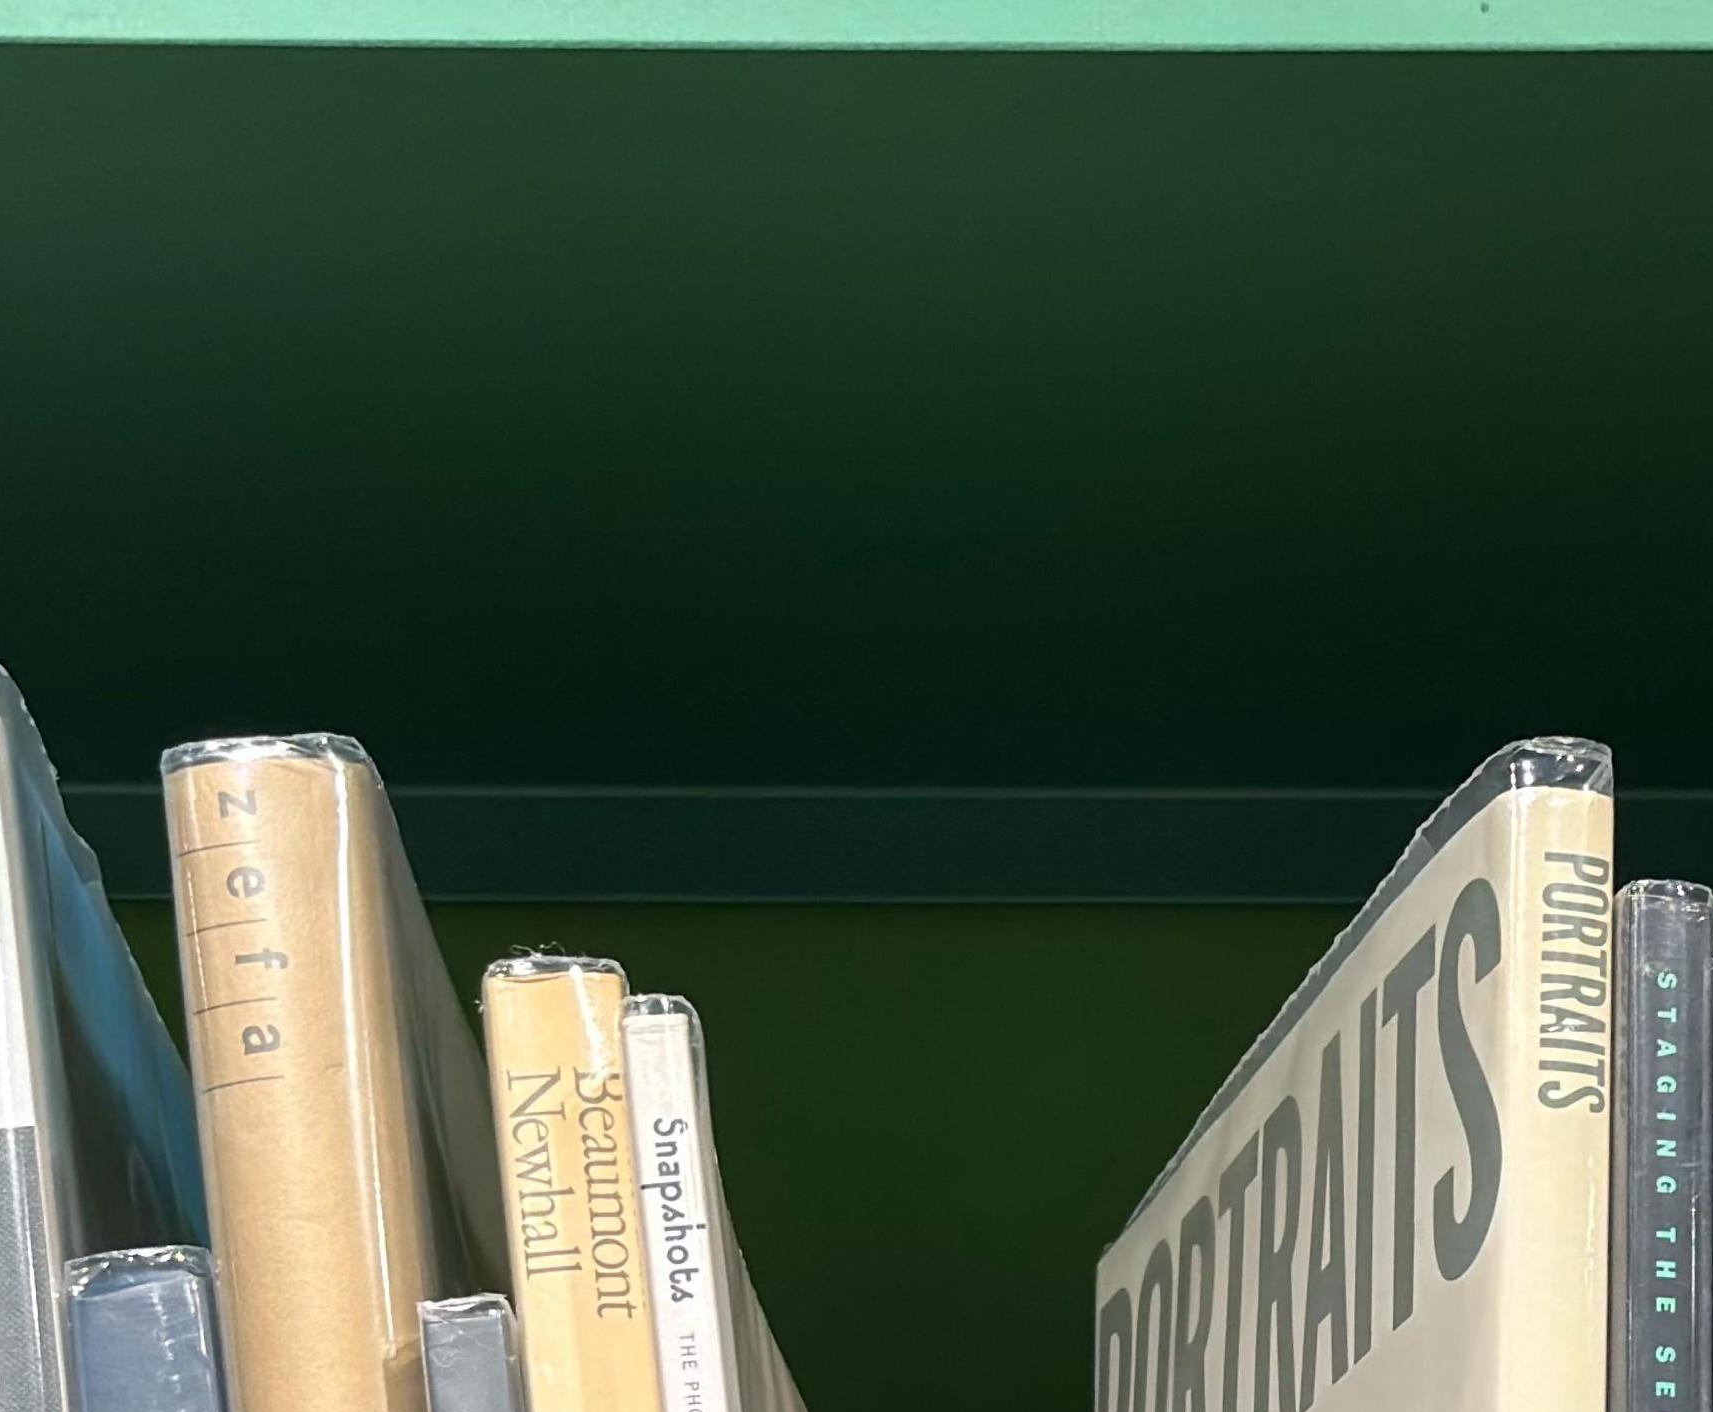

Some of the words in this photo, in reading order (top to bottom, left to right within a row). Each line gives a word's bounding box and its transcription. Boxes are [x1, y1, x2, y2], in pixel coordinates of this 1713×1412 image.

[1540, 851, 1610, 1113] PORTRAITS
[1655, 971, 1677, 1194] STAGING
[507, 1065, 583, 1280] Newhall
[573, 1067, 637, 1319] Beaumont
[640, 1117, 709, 1303] Snapshots
[1655, 1228, 1676, 1313] THE
